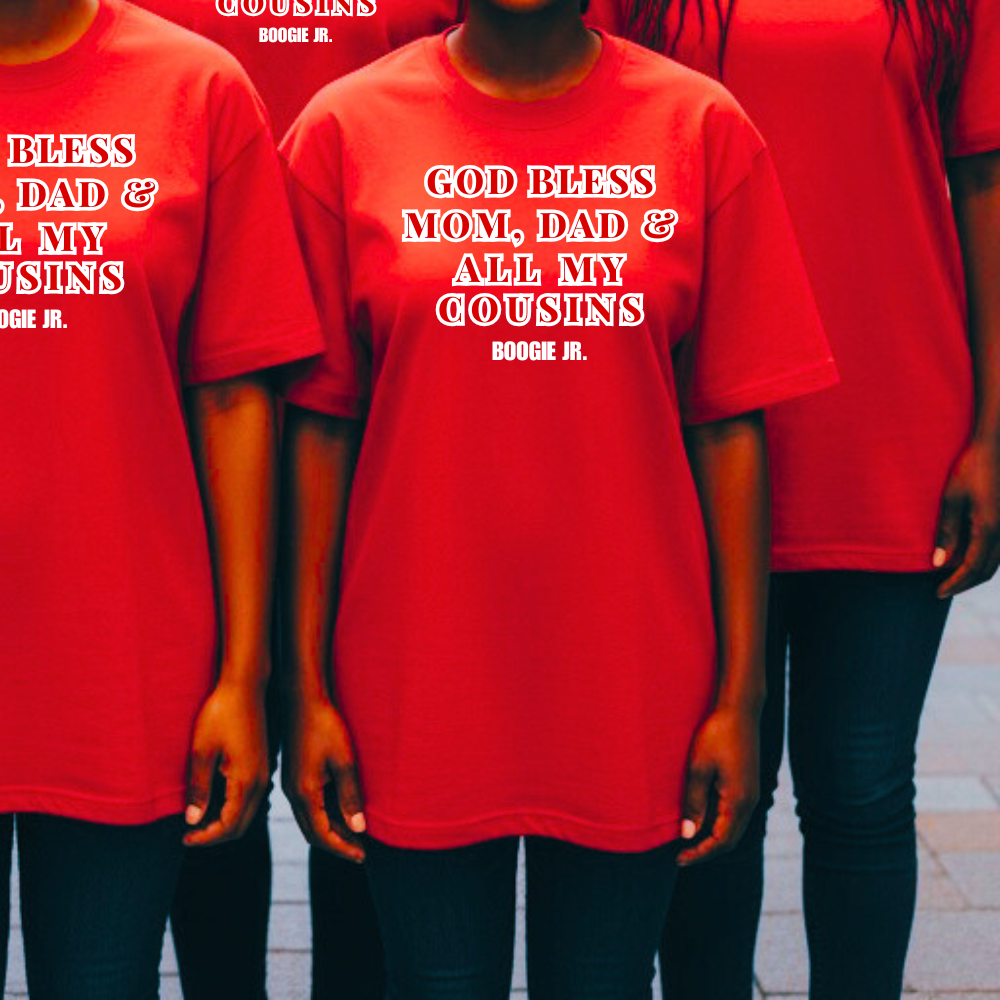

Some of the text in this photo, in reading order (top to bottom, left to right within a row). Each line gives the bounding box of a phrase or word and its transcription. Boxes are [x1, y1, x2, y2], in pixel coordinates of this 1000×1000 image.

[258, 27, 333, 43] BOOGIE JR.
[6, 133, 137, 168] BLESS
[16, 177, 109, 212] DAD
[120, 177, 160, 212] &
[423, 164, 657, 199] GOD BLESS
[37, 221, 108, 256] MY
[401, 208, 679, 249] MOM, DAD &
[451, 252, 628, 287] ALL MY
[42, 308, 68, 329] JR.
[435, 292, 645, 327] COUSINS
[492, 340, 588, 361] BOOGIE JR.
